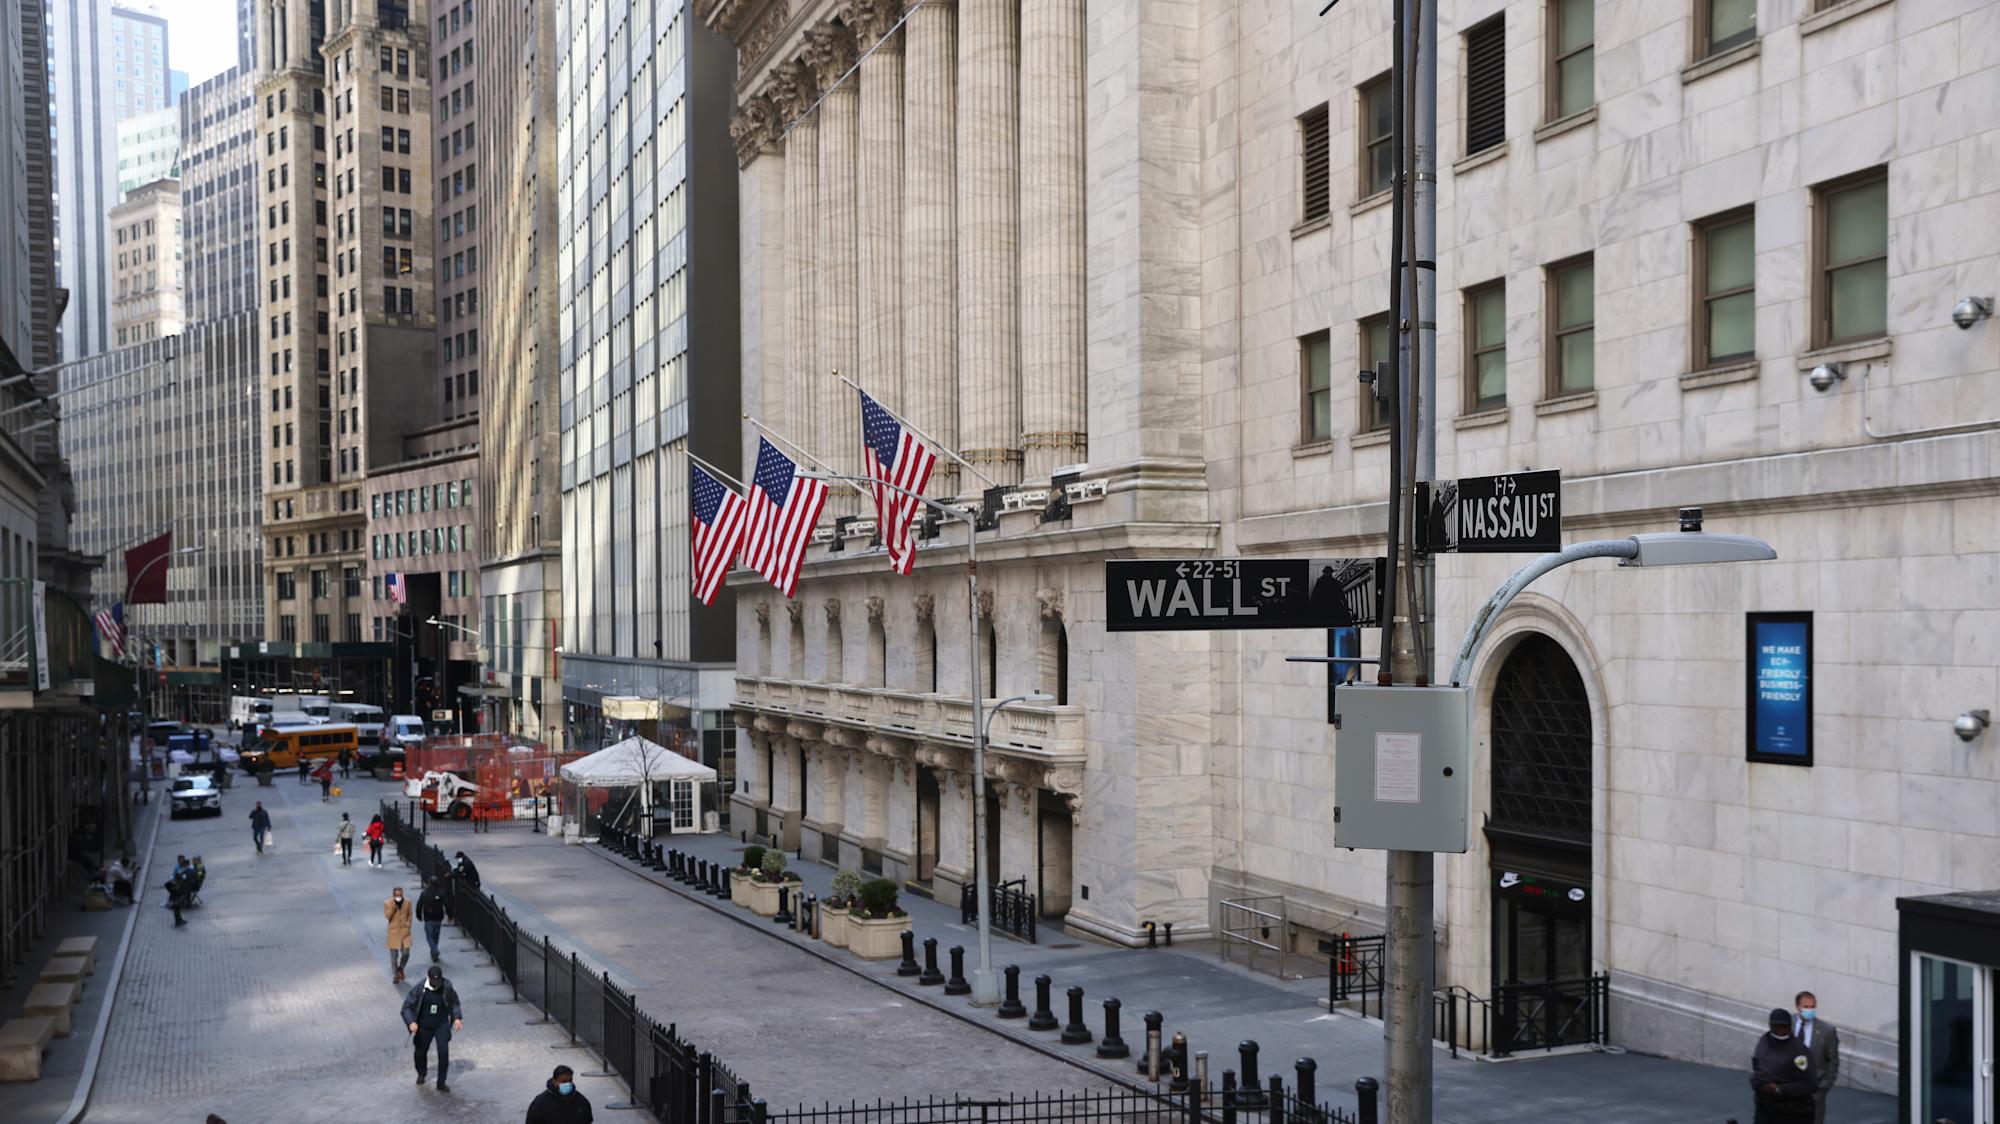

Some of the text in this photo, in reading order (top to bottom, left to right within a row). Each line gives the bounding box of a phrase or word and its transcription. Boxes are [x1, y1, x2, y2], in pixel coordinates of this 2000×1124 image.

[1494, 476, 1507, 496] 1-7
[1462, 492, 1555, 538] NASSAU ST
[1192, 561, 1241, 579] 22-51
[1126, 577, 1291, 618] WALL ST
[1761, 646, 1801, 655] WE MAKE
[1761, 669, 1801, 679] FRIENDLY
[1761, 691, 1801, 701] FRIENDLY
